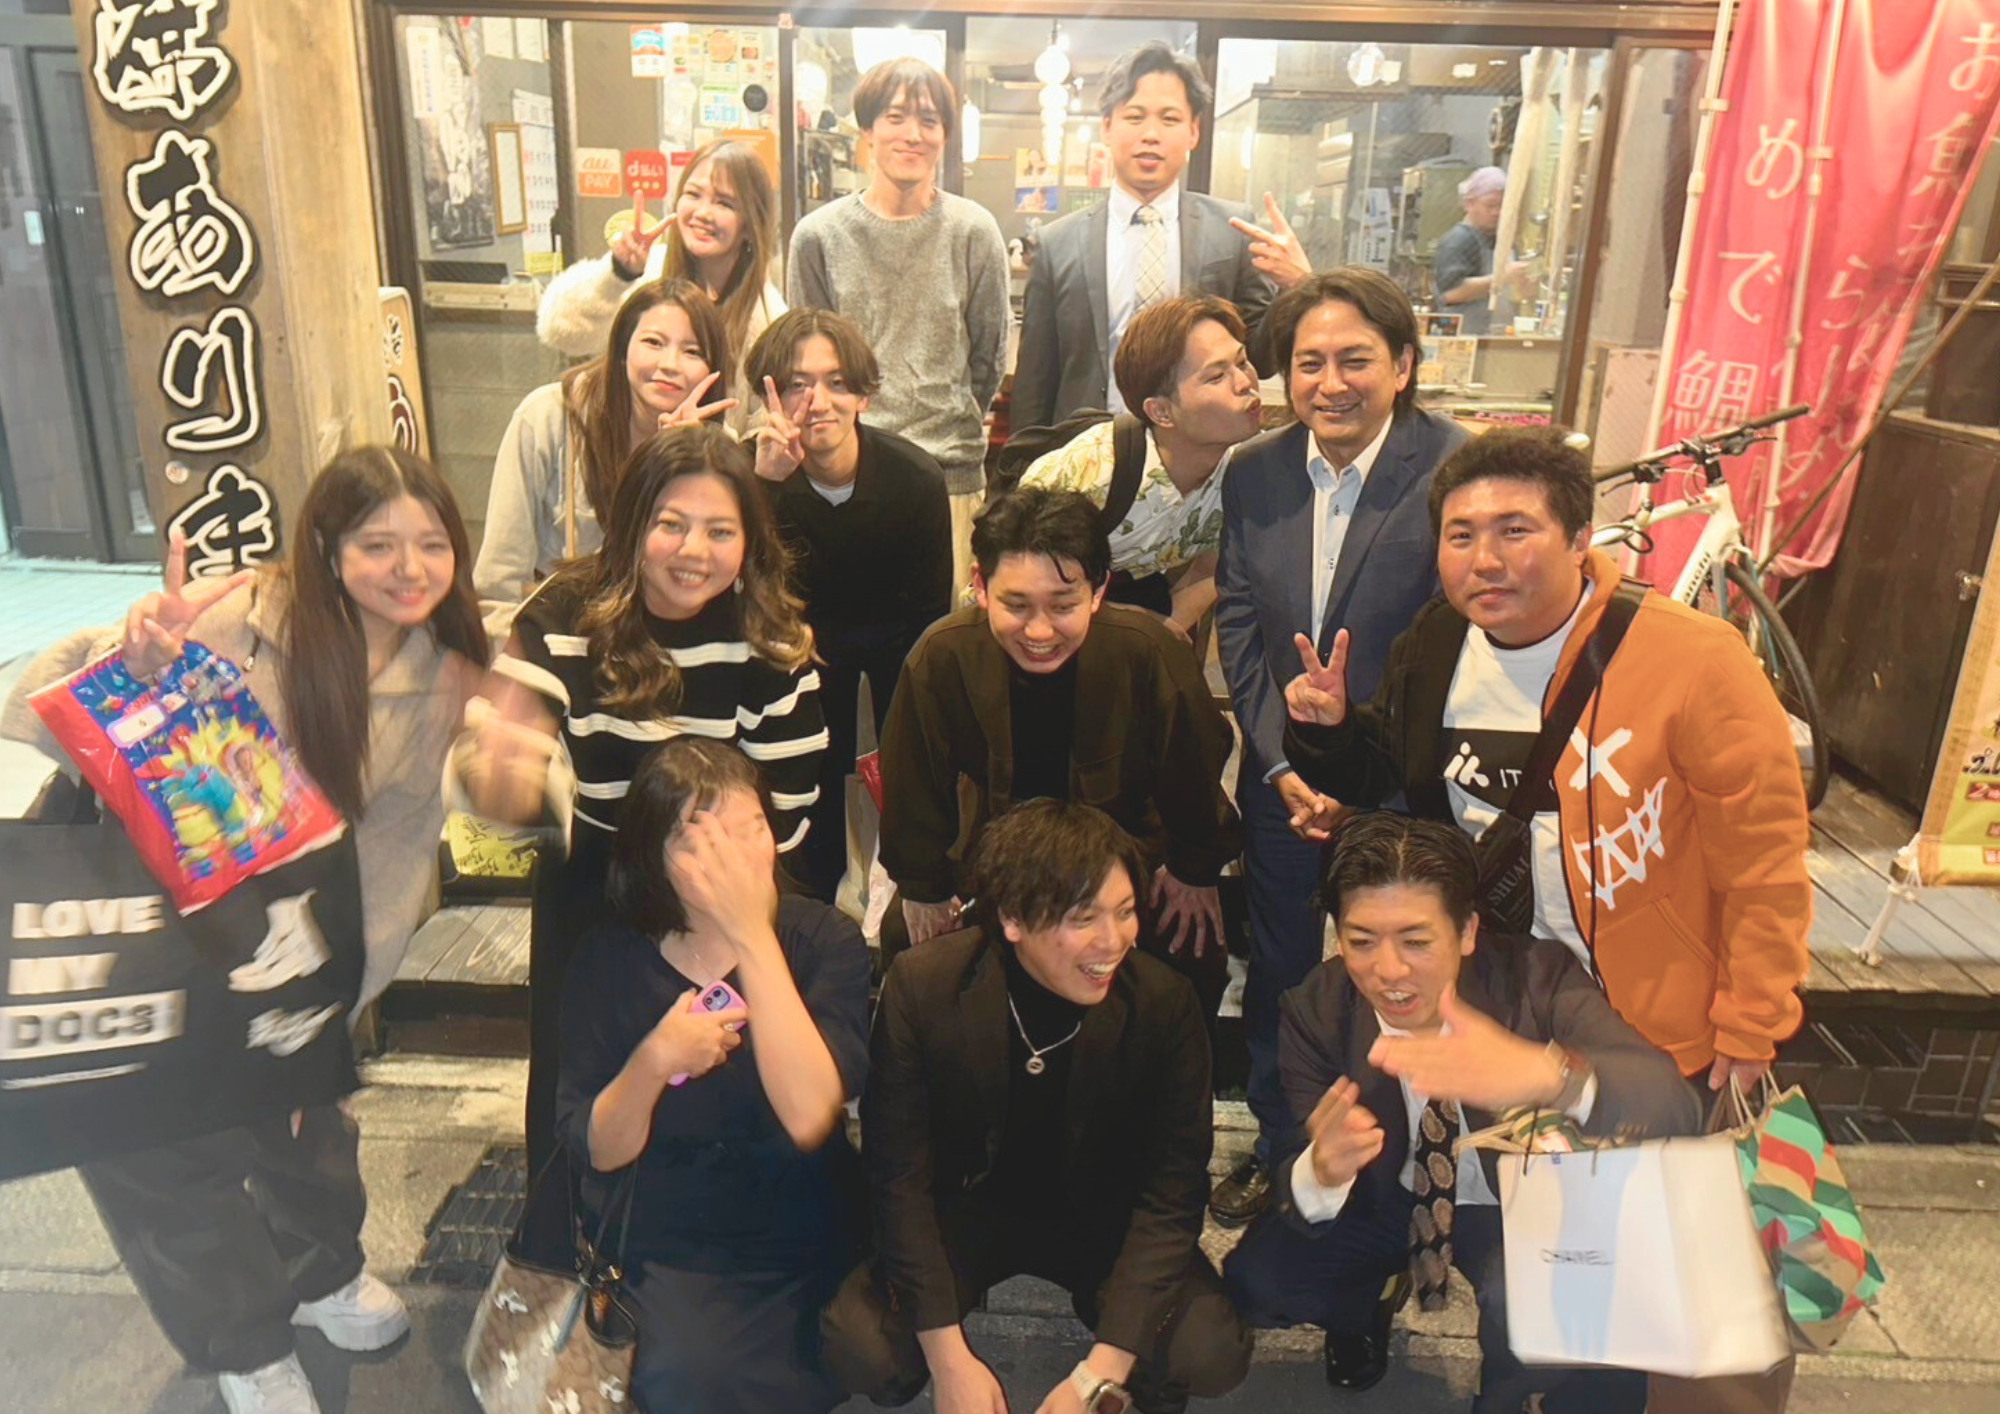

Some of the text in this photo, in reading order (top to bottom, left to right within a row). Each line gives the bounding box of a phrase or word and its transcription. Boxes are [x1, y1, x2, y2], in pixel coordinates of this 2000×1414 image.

[584, 174, 612, 188] PAY
[12, 895, 165, 938] LOVE
[8, 953, 119, 994] MY
